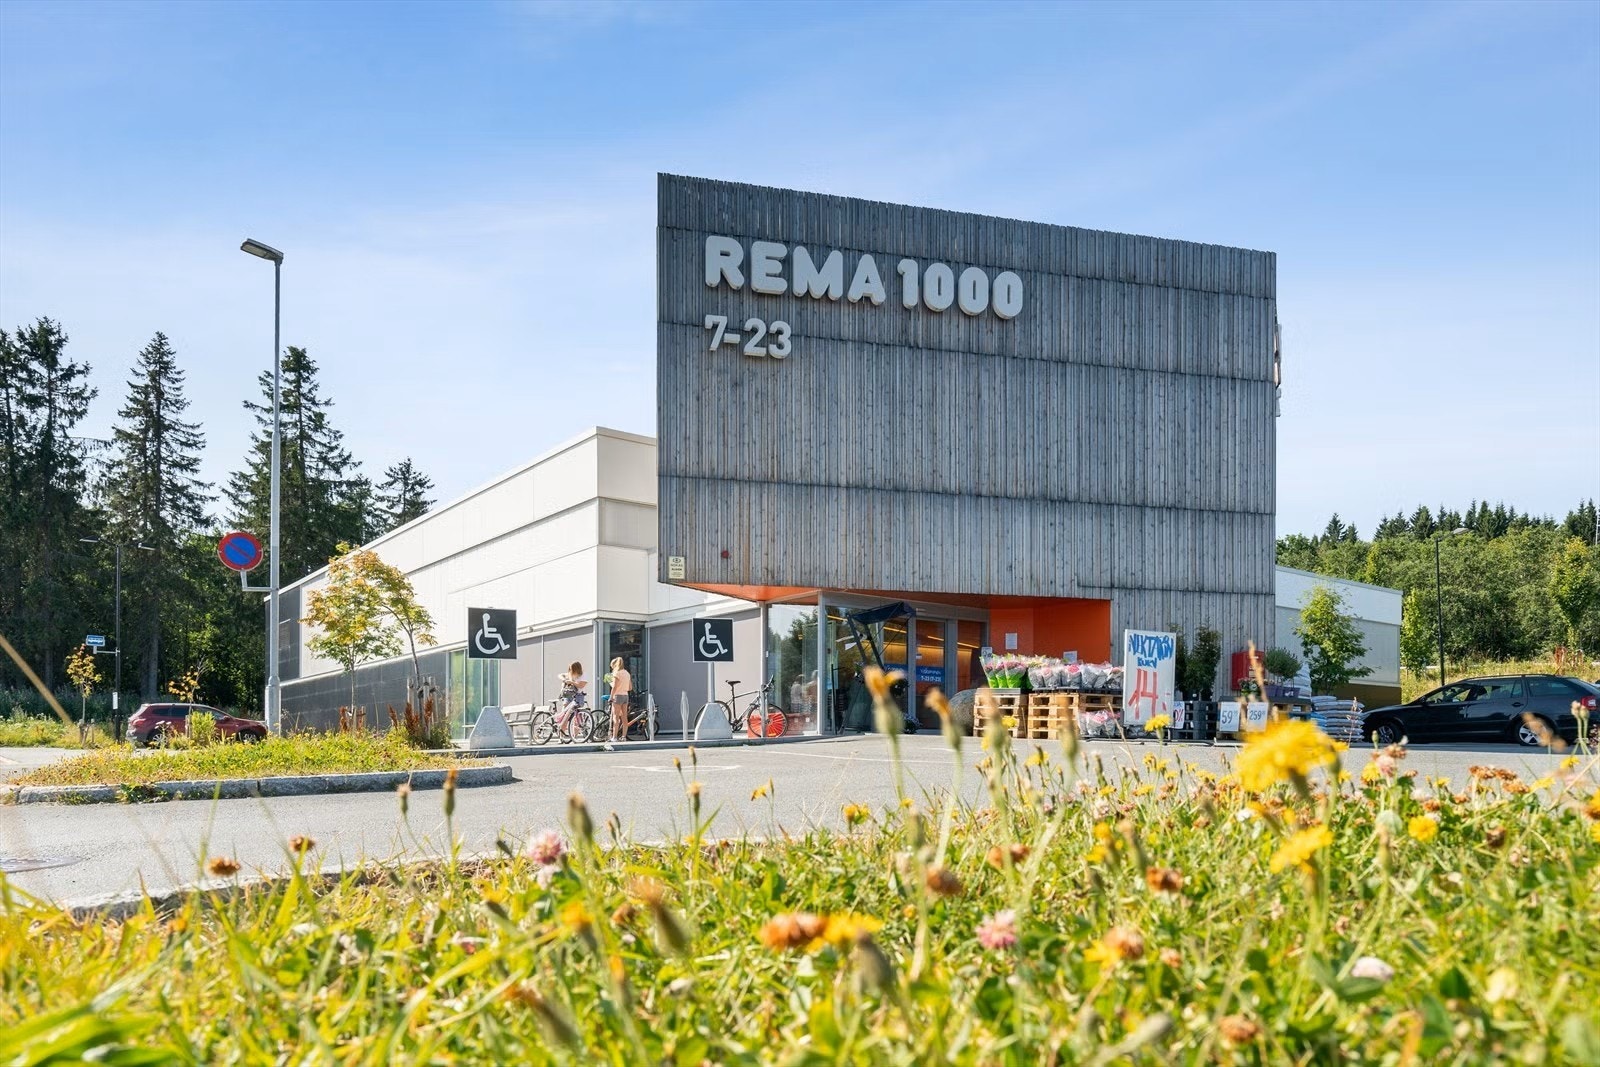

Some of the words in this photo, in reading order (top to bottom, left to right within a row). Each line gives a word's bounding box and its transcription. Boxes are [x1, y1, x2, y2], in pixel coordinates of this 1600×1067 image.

[705, 235, 886, 306] REMA
[897, 258, 1024, 320] 1000
[704, 314, 792, 360] 7-23
